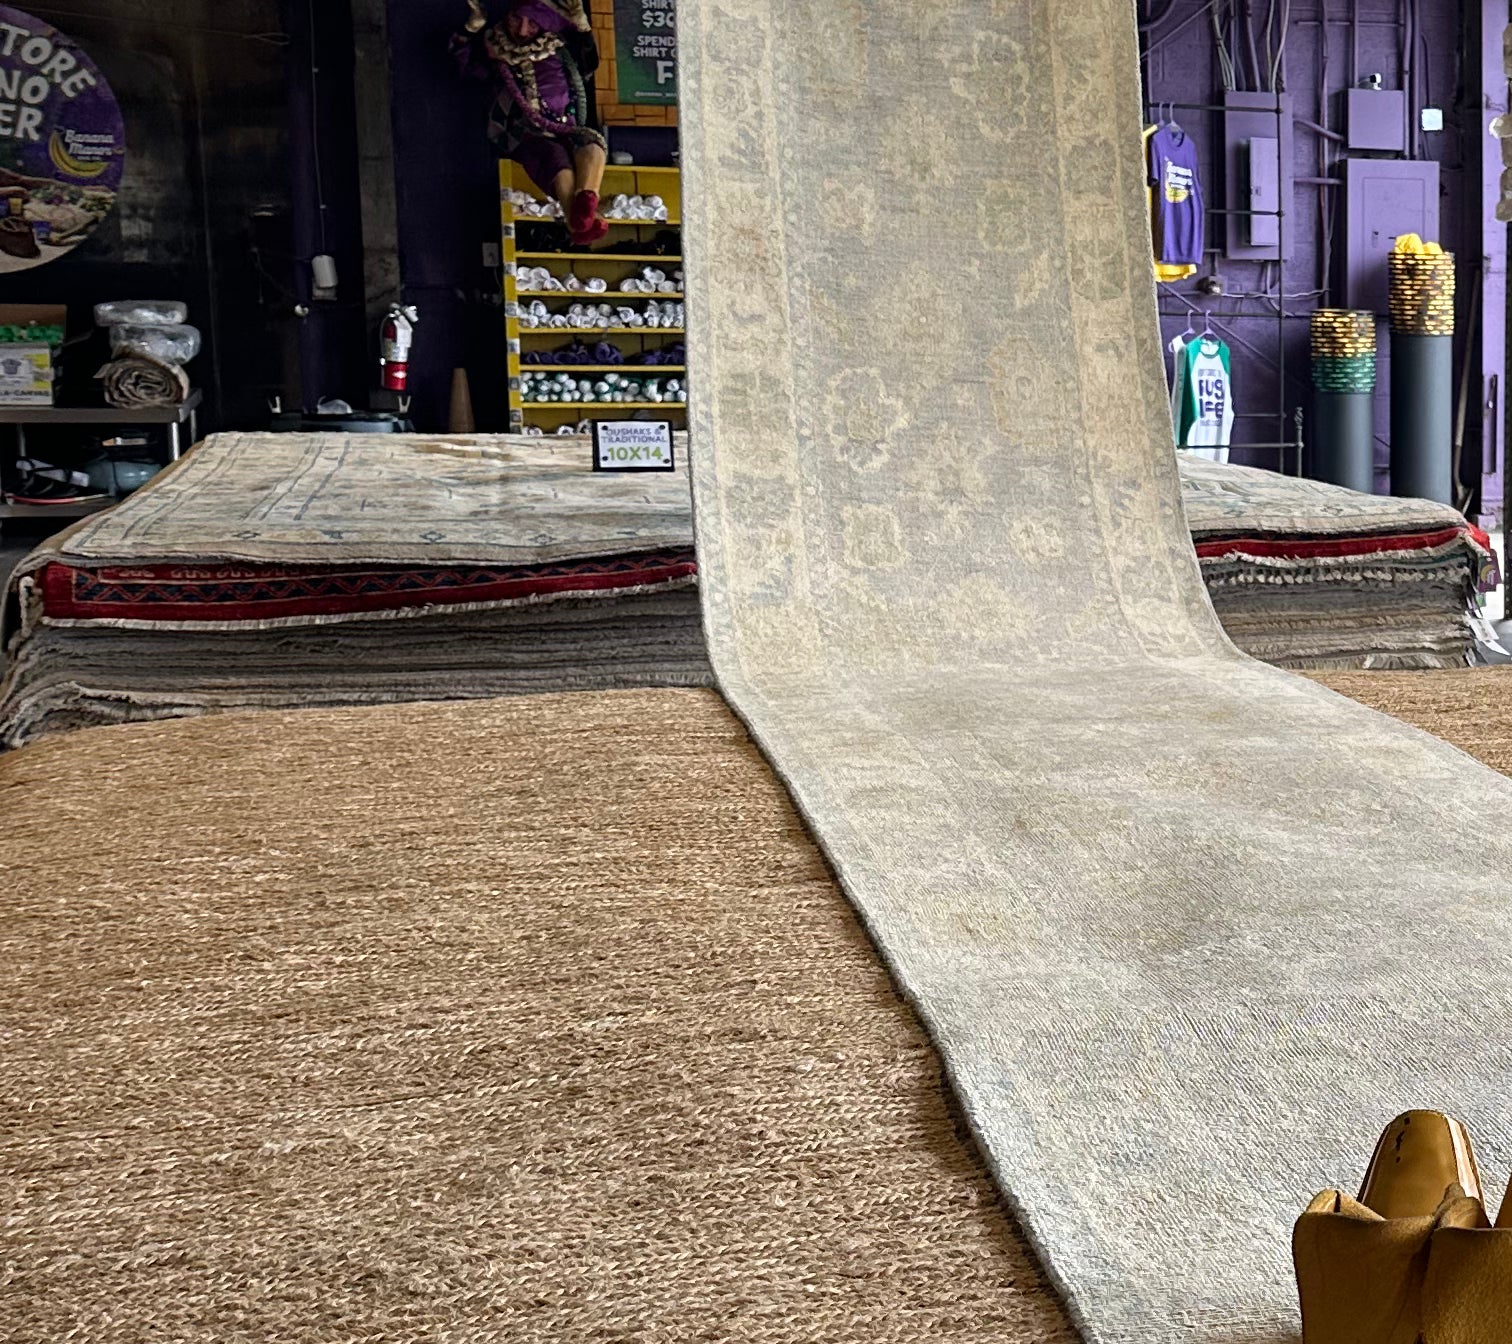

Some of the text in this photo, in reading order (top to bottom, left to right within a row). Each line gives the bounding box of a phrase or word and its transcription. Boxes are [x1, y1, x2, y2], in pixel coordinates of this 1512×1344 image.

[637, 35, 676, 46] SPEND
[633, 46, 668, 57] SHIRT
[601, 436, 667, 444] TRADITIONAL
[608, 446, 664, 462] 10X14
